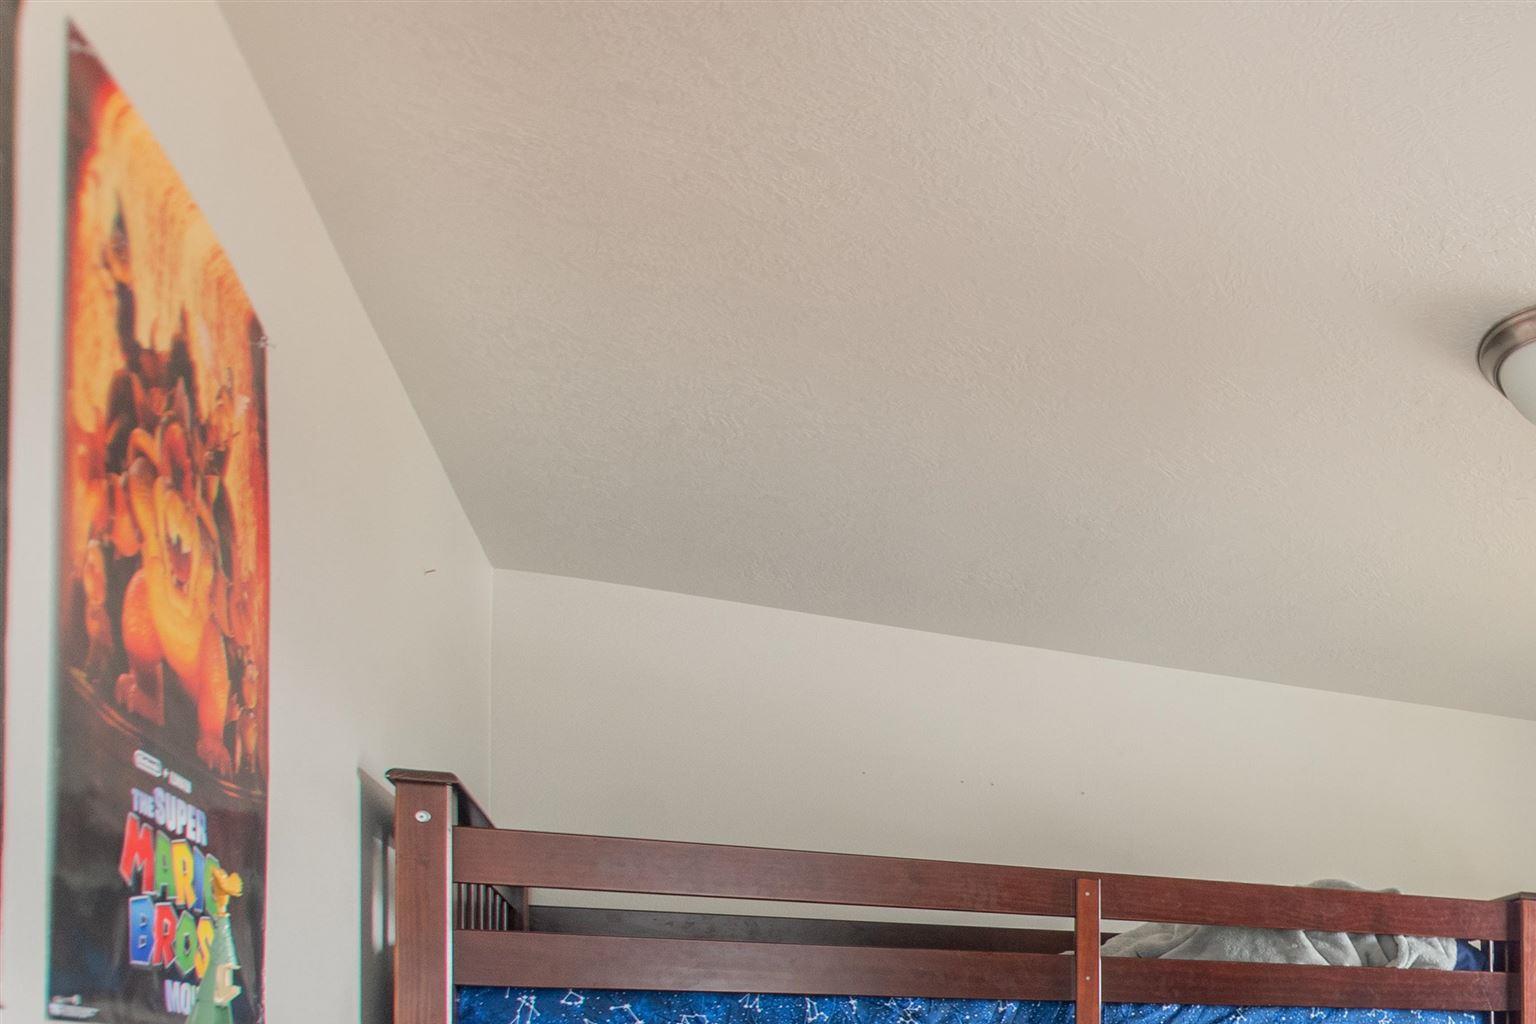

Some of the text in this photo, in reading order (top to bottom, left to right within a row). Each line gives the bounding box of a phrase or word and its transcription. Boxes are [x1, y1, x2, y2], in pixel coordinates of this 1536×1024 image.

[131, 786, 208, 847] THE SUPER
[118, 811, 222, 916] MARIO
[129, 894, 215, 978] BROS
